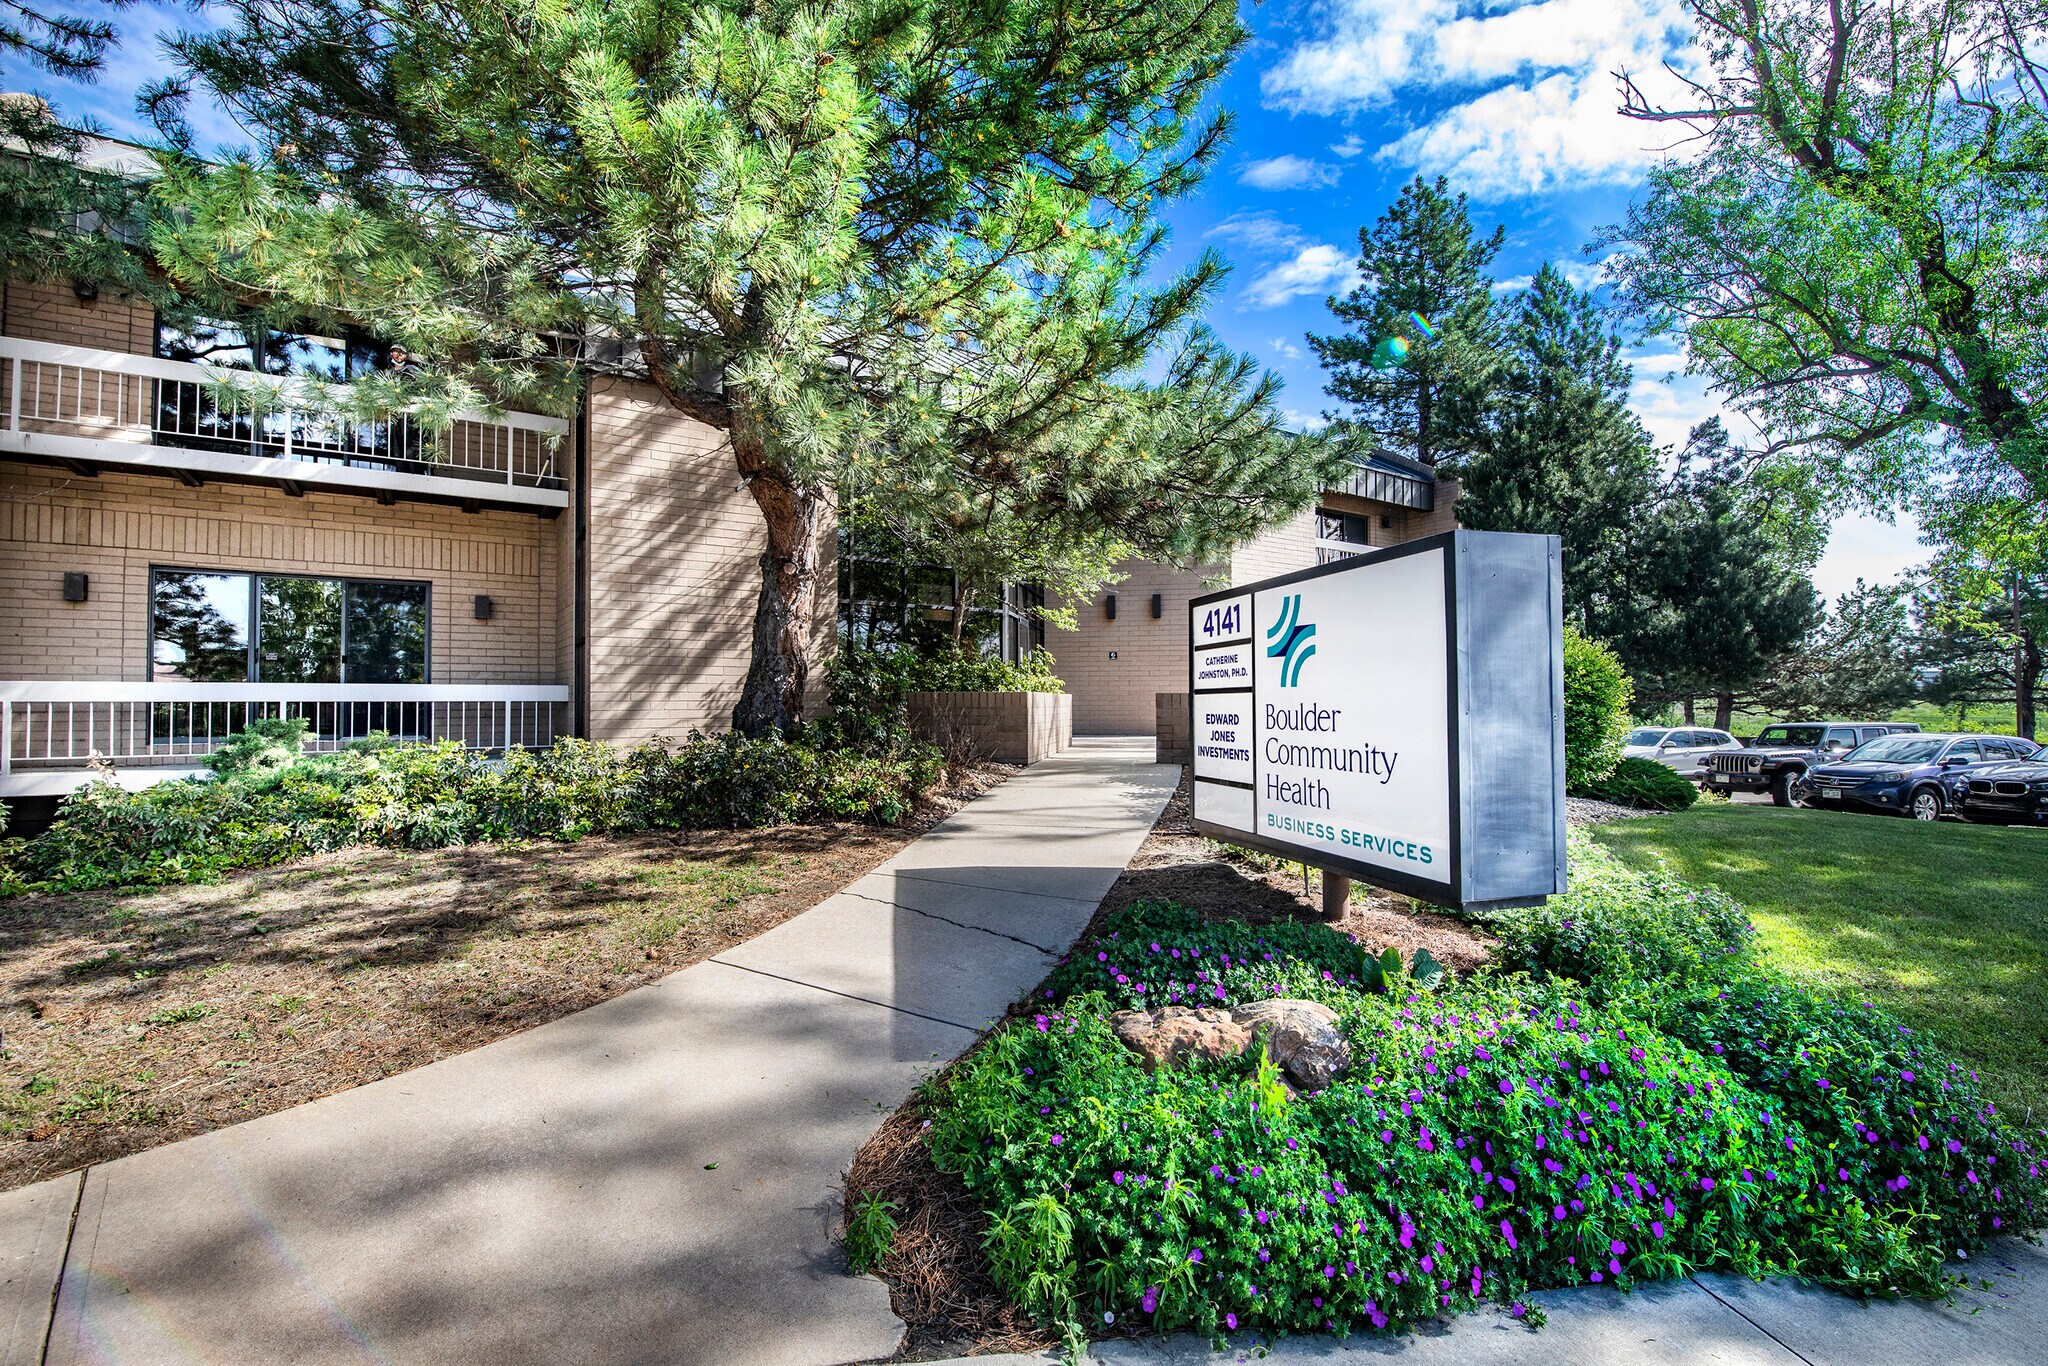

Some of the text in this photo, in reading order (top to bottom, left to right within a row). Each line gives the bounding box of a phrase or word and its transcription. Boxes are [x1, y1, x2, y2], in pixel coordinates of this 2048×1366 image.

[1203, 603, 1240, 638] 4141
[1205, 654, 1239, 666] CATHERINE
[1198, 667, 1248, 680] JOHNSTON, PH.D.
[1205, 713, 1240, 726] EDWARD
[1265, 702, 1342, 732] Boulder
[1210, 730, 1236, 743] JONES
[1197, 745, 1250, 762] INVESTMENTS
[1265, 737, 1399, 785] Community
[1266, 773, 1331, 810] Health
[1267, 813, 1433, 864] BUSINESS SERVICES
